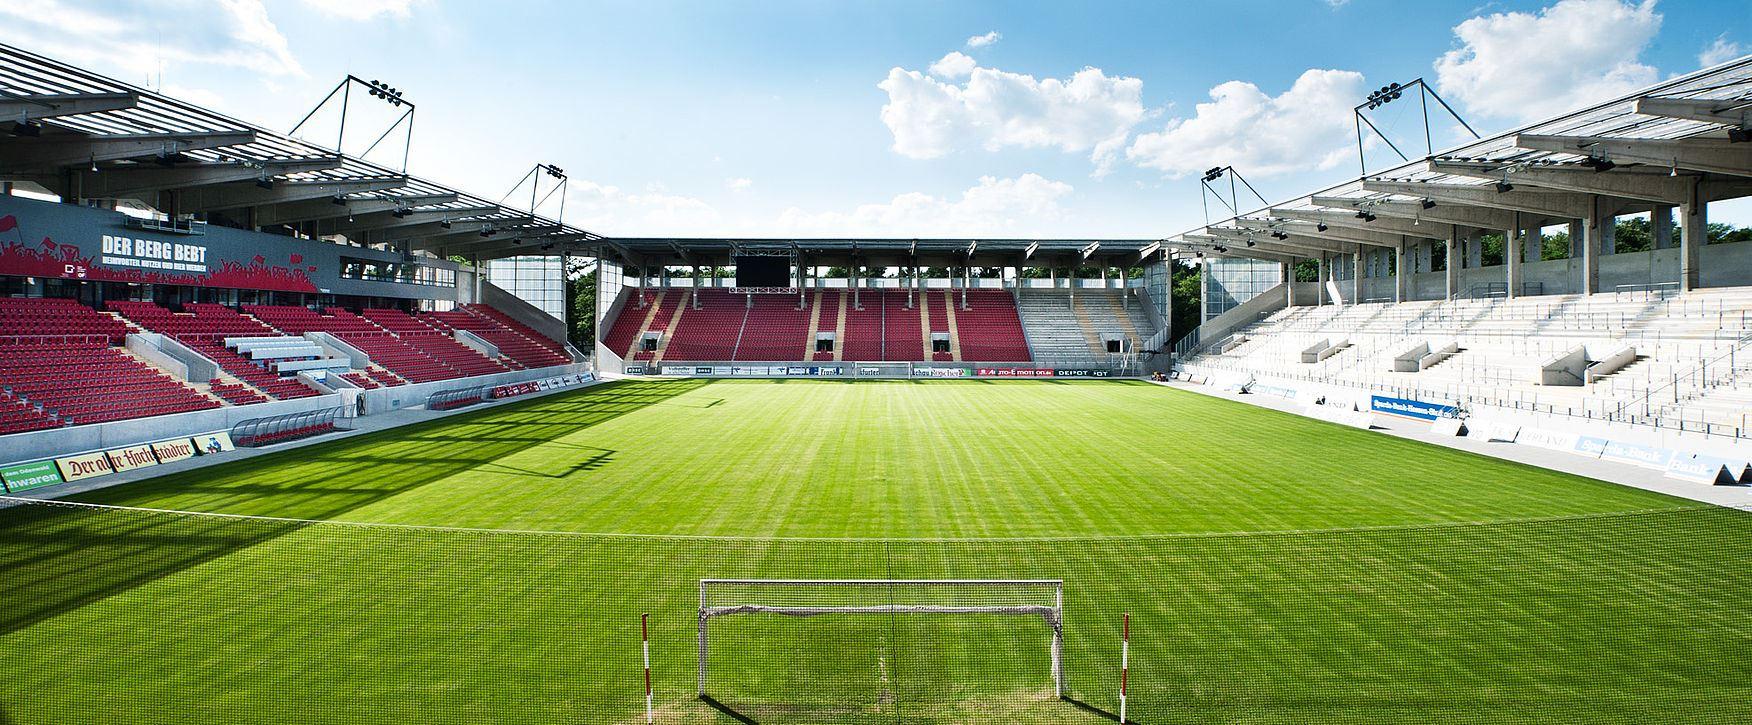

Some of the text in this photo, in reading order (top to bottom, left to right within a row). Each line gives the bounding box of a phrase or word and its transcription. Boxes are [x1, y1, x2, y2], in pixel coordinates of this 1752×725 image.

[102, 234, 207, 263] DER BERG BEBT
[68, 460, 96, 477] Der
